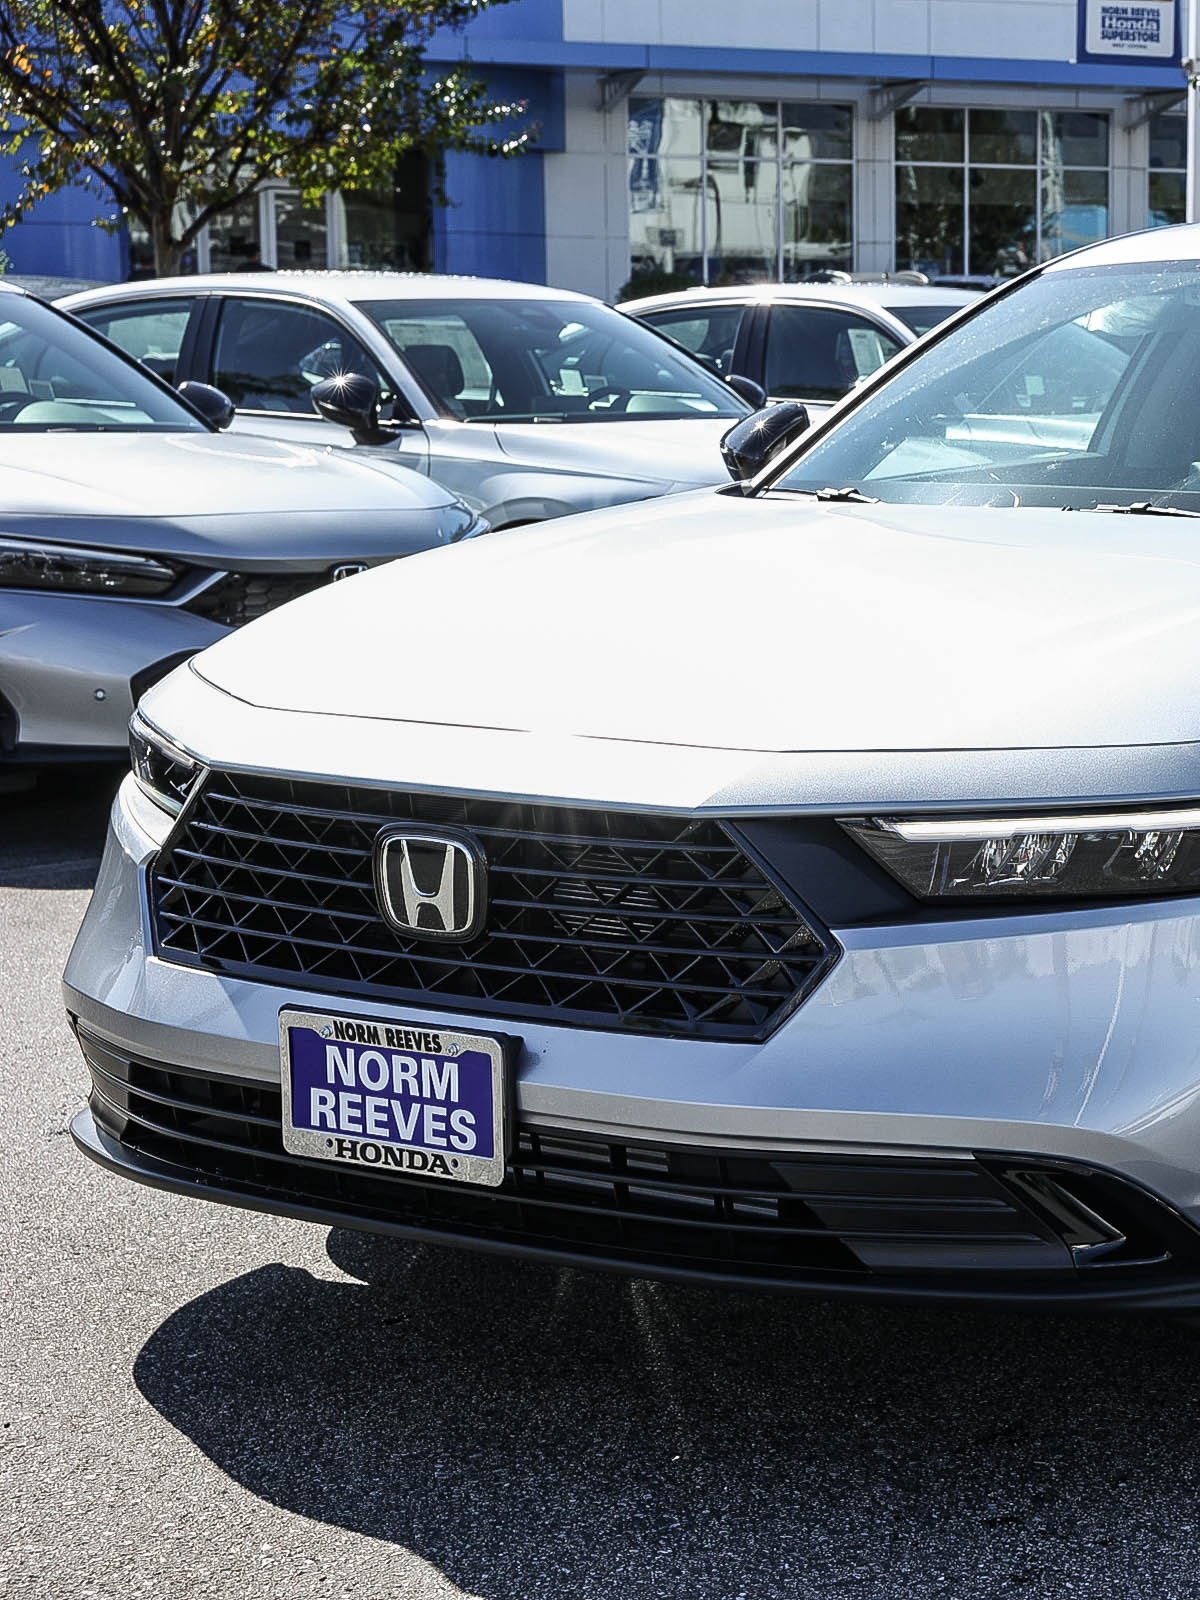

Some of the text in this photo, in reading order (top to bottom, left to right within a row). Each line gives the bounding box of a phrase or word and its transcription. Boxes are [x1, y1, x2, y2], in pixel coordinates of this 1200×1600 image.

[1101, 30, 1160, 42] SUPERSTORE
[1105, 16, 1158, 30] Honda
[333, 1020, 442, 1053] NORM REEVES
[326, 1045, 459, 1103] NORM
[310, 1087, 477, 1151] REEVES
[334, 1138, 453, 1176] HONDA
